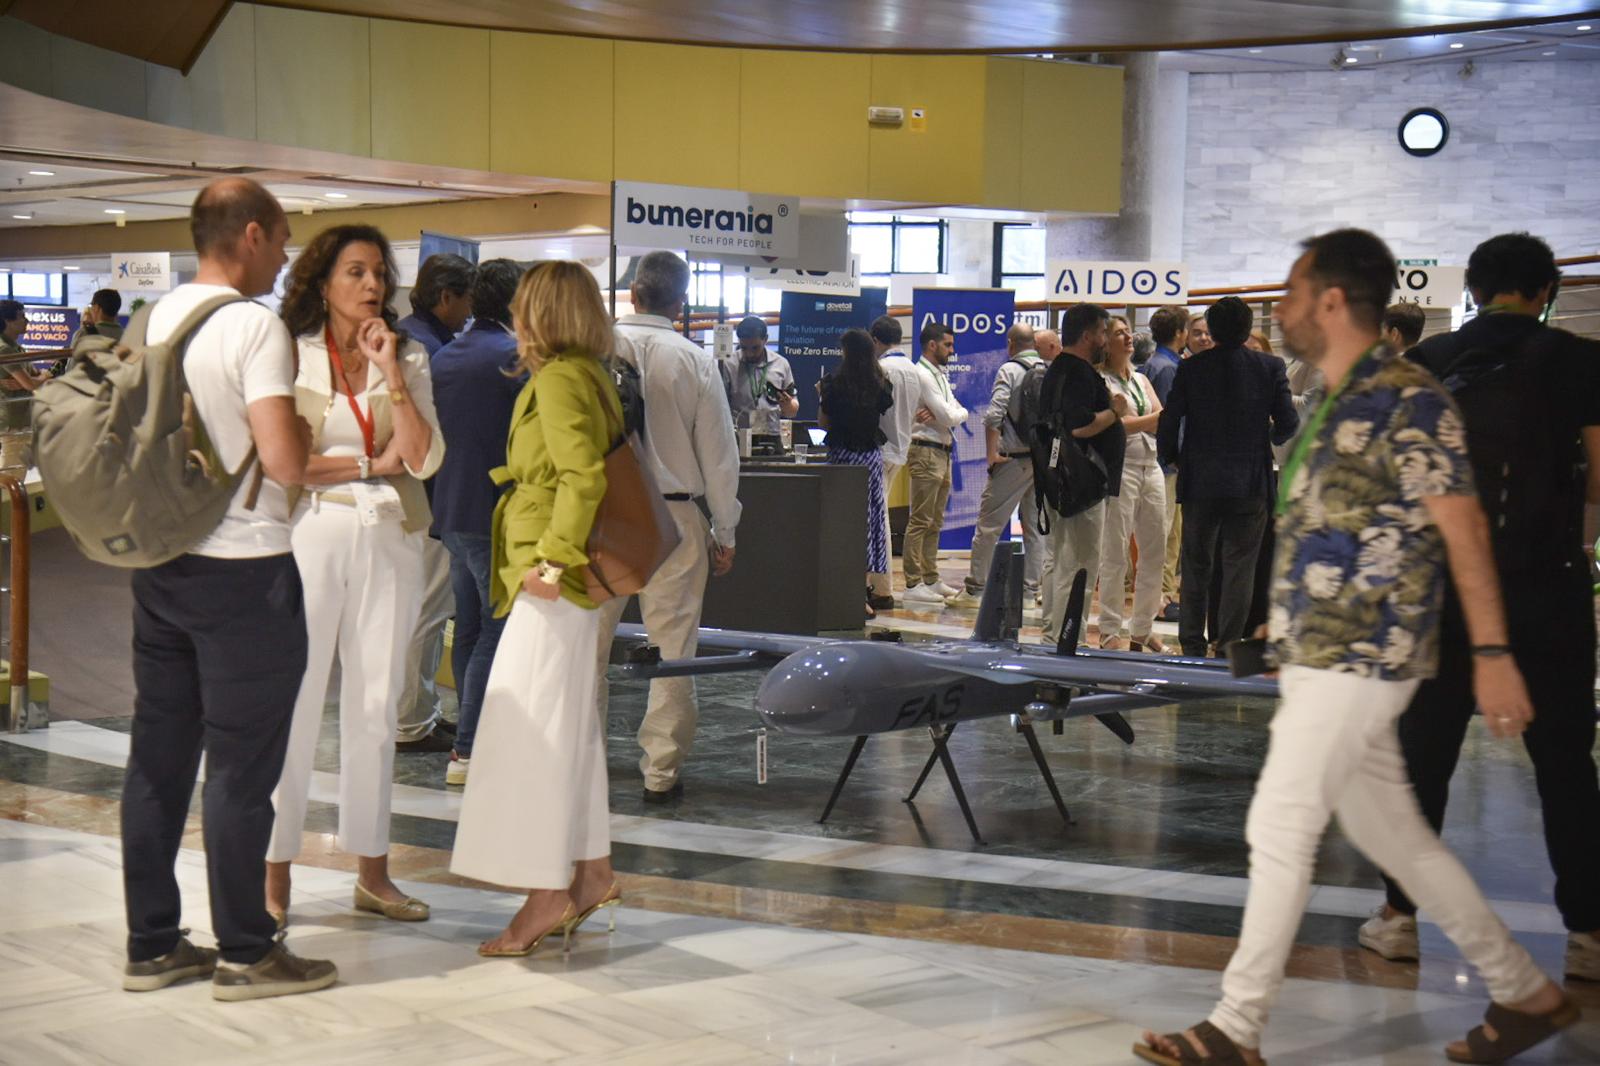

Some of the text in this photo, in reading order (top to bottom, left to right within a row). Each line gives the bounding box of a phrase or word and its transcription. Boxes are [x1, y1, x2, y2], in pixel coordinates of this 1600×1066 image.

[627, 198, 773, 234] bumerania
[690, 235, 773, 249] TECH FOR PEOPLE
[1055, 269, 1181, 296] AIDOS
[785, 325, 799, 333] The
[801, 326, 824, 334] future
[784, 346, 801, 355] True
[803, 347, 821, 355] Zero
[891, 684, 965, 729] FAS
